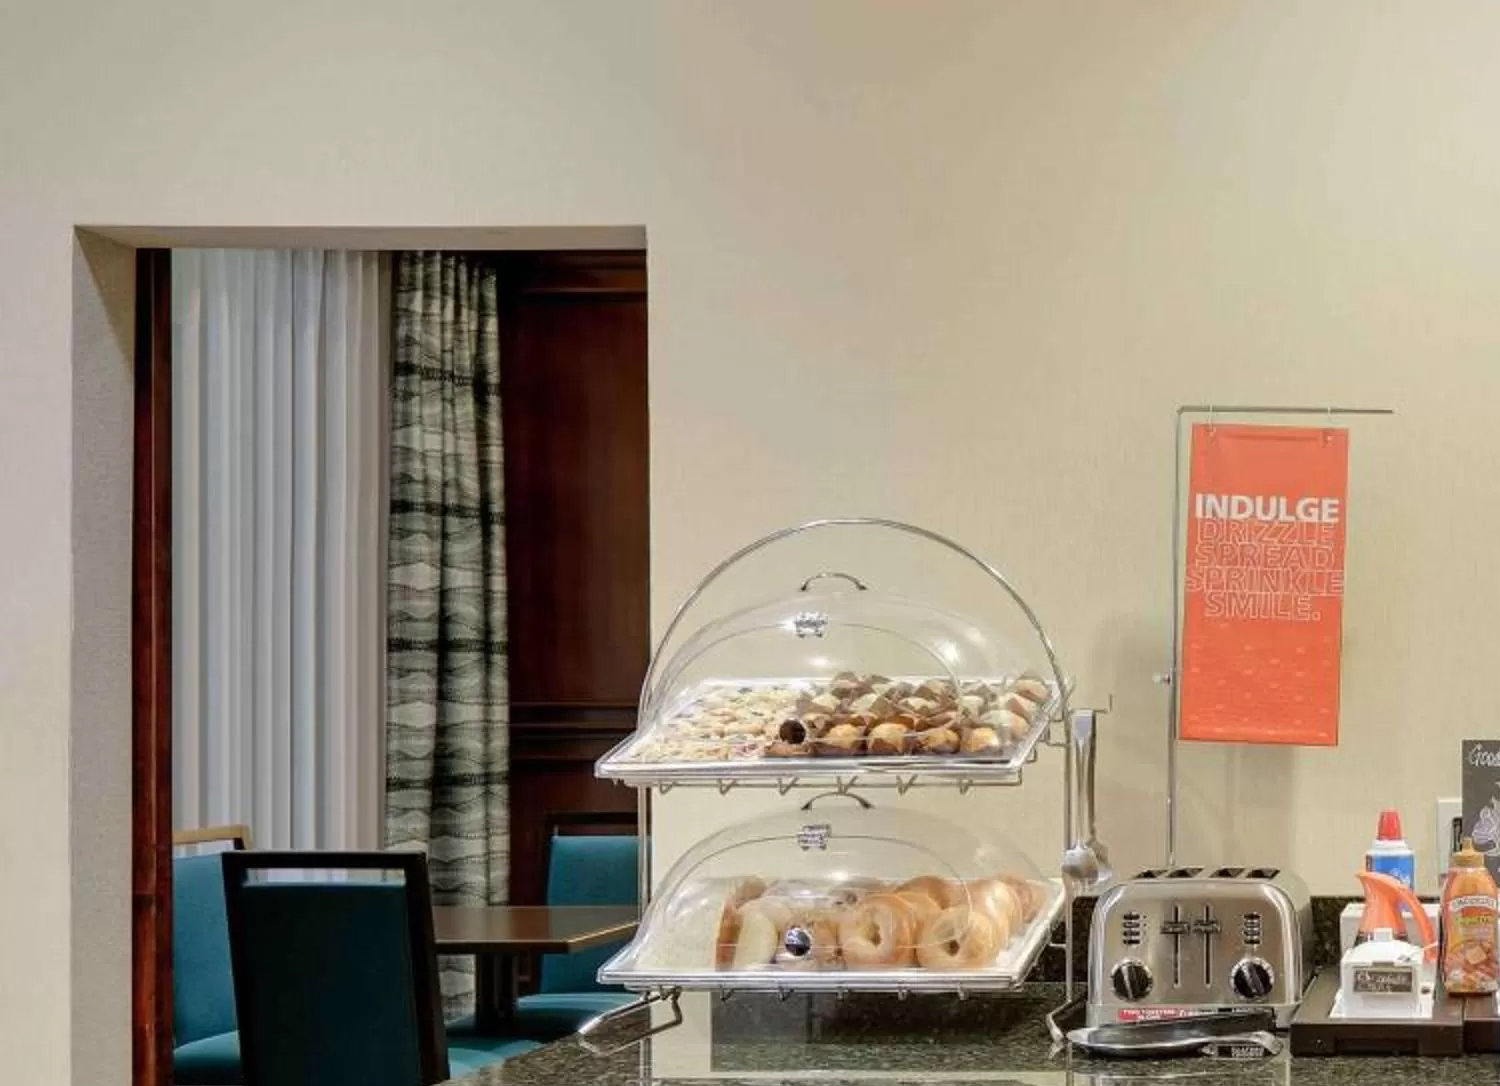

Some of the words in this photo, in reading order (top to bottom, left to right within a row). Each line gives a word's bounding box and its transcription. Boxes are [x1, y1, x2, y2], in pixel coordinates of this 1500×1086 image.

[1195, 493, 1340, 523] INDULGE
[1197, 518, 1336, 547] DRIZZLE
[1195, 543, 1336, 571] SPREAD
[1186, 566, 1344, 597] SPRINKLE
[1204, 591, 1321, 621] SMILE.
